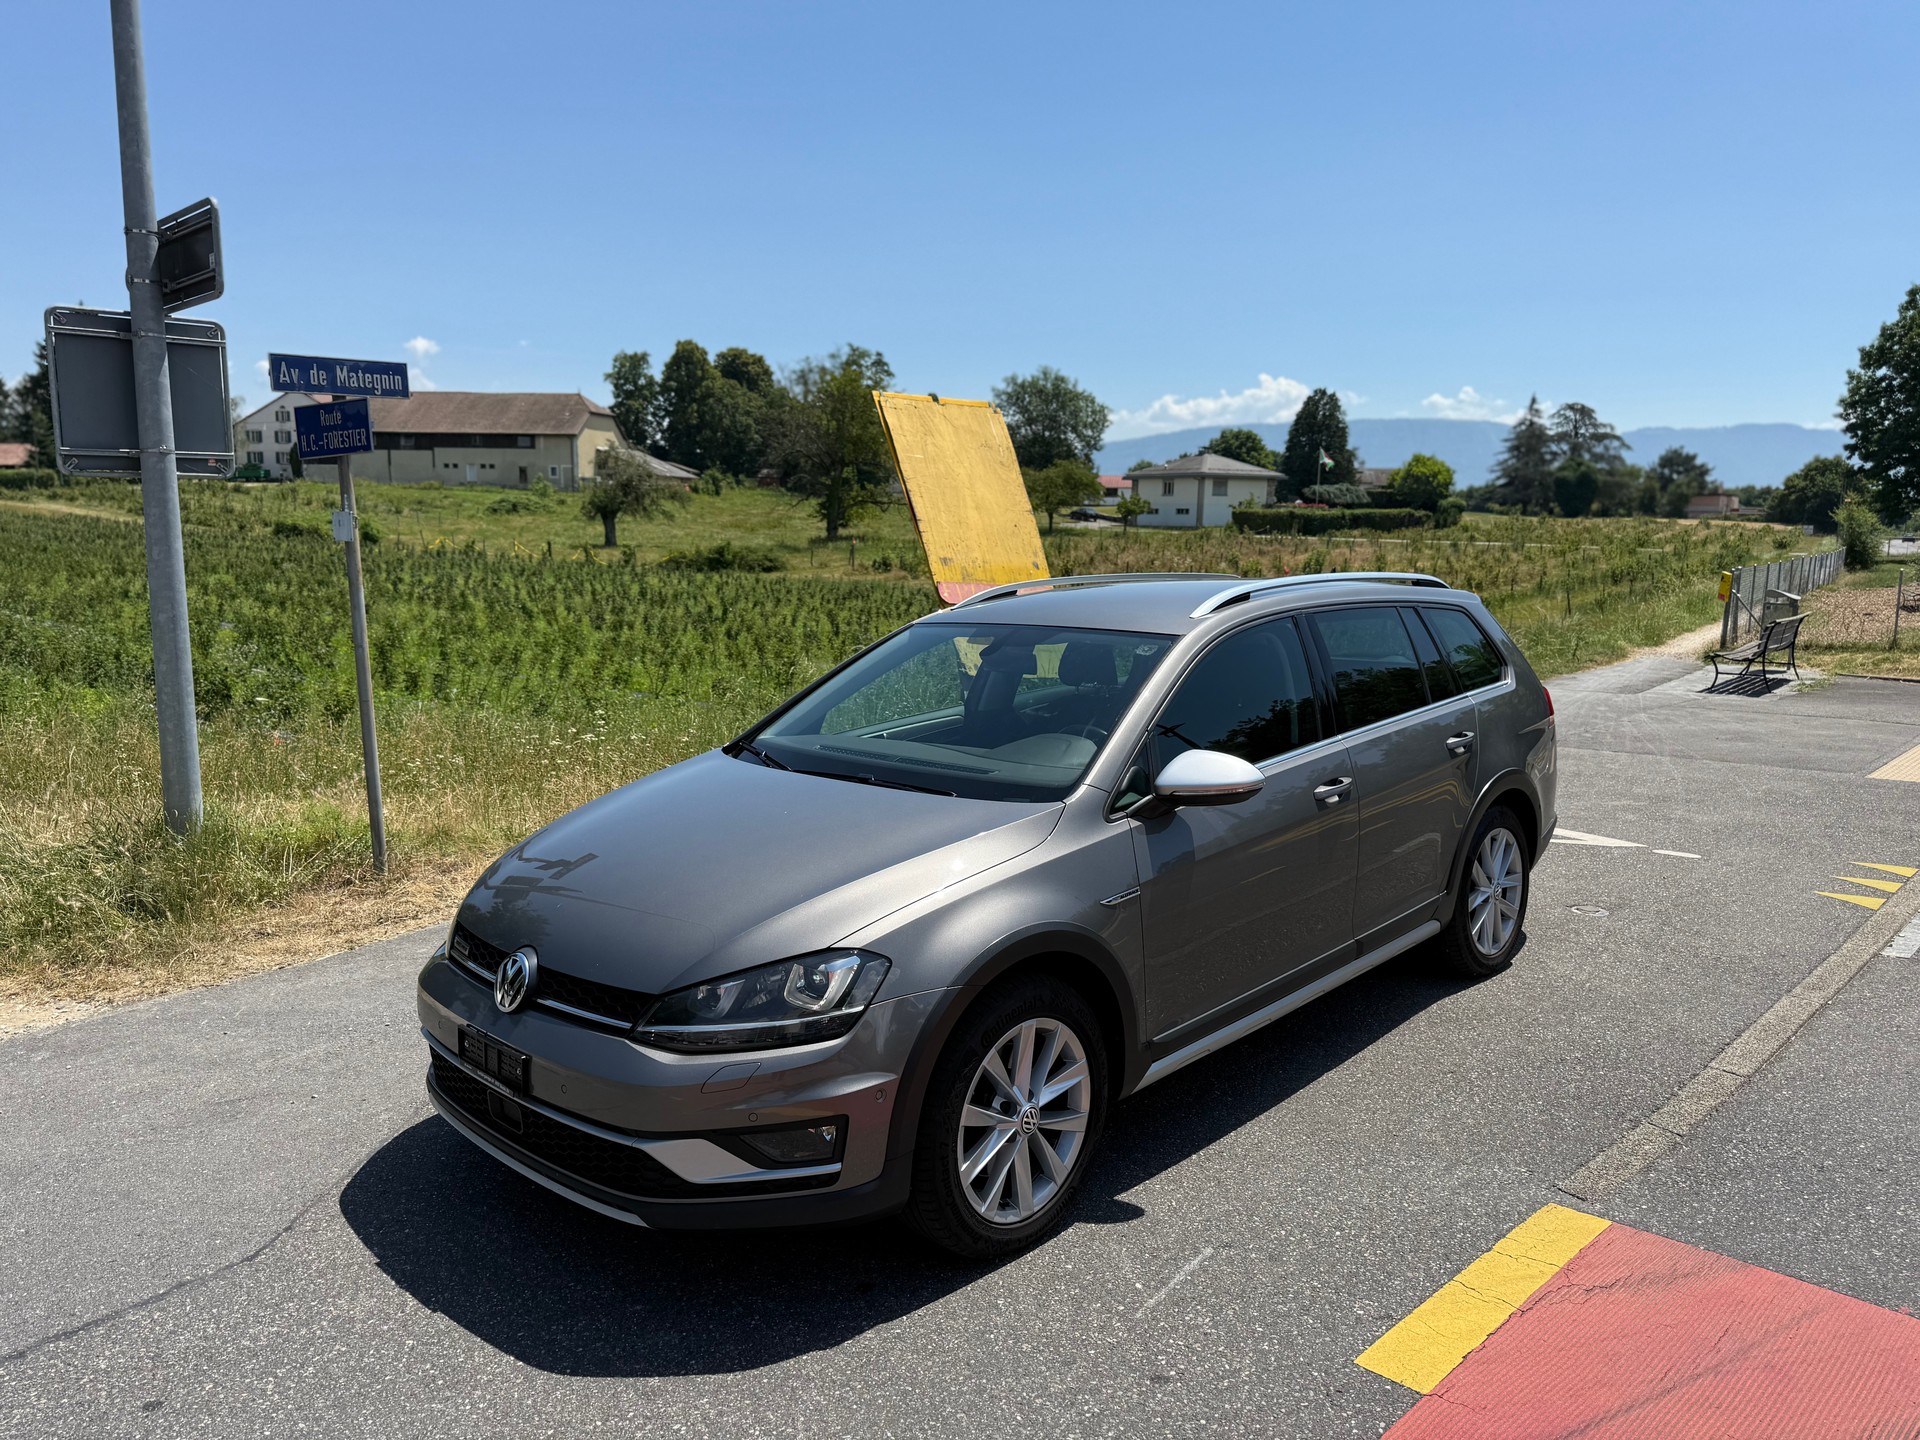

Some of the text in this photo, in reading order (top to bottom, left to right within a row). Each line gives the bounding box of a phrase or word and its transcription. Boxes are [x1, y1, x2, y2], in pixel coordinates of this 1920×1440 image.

[280, 361, 403, 395] Av. de Mategnin
[320, 410, 342, 427] Route
